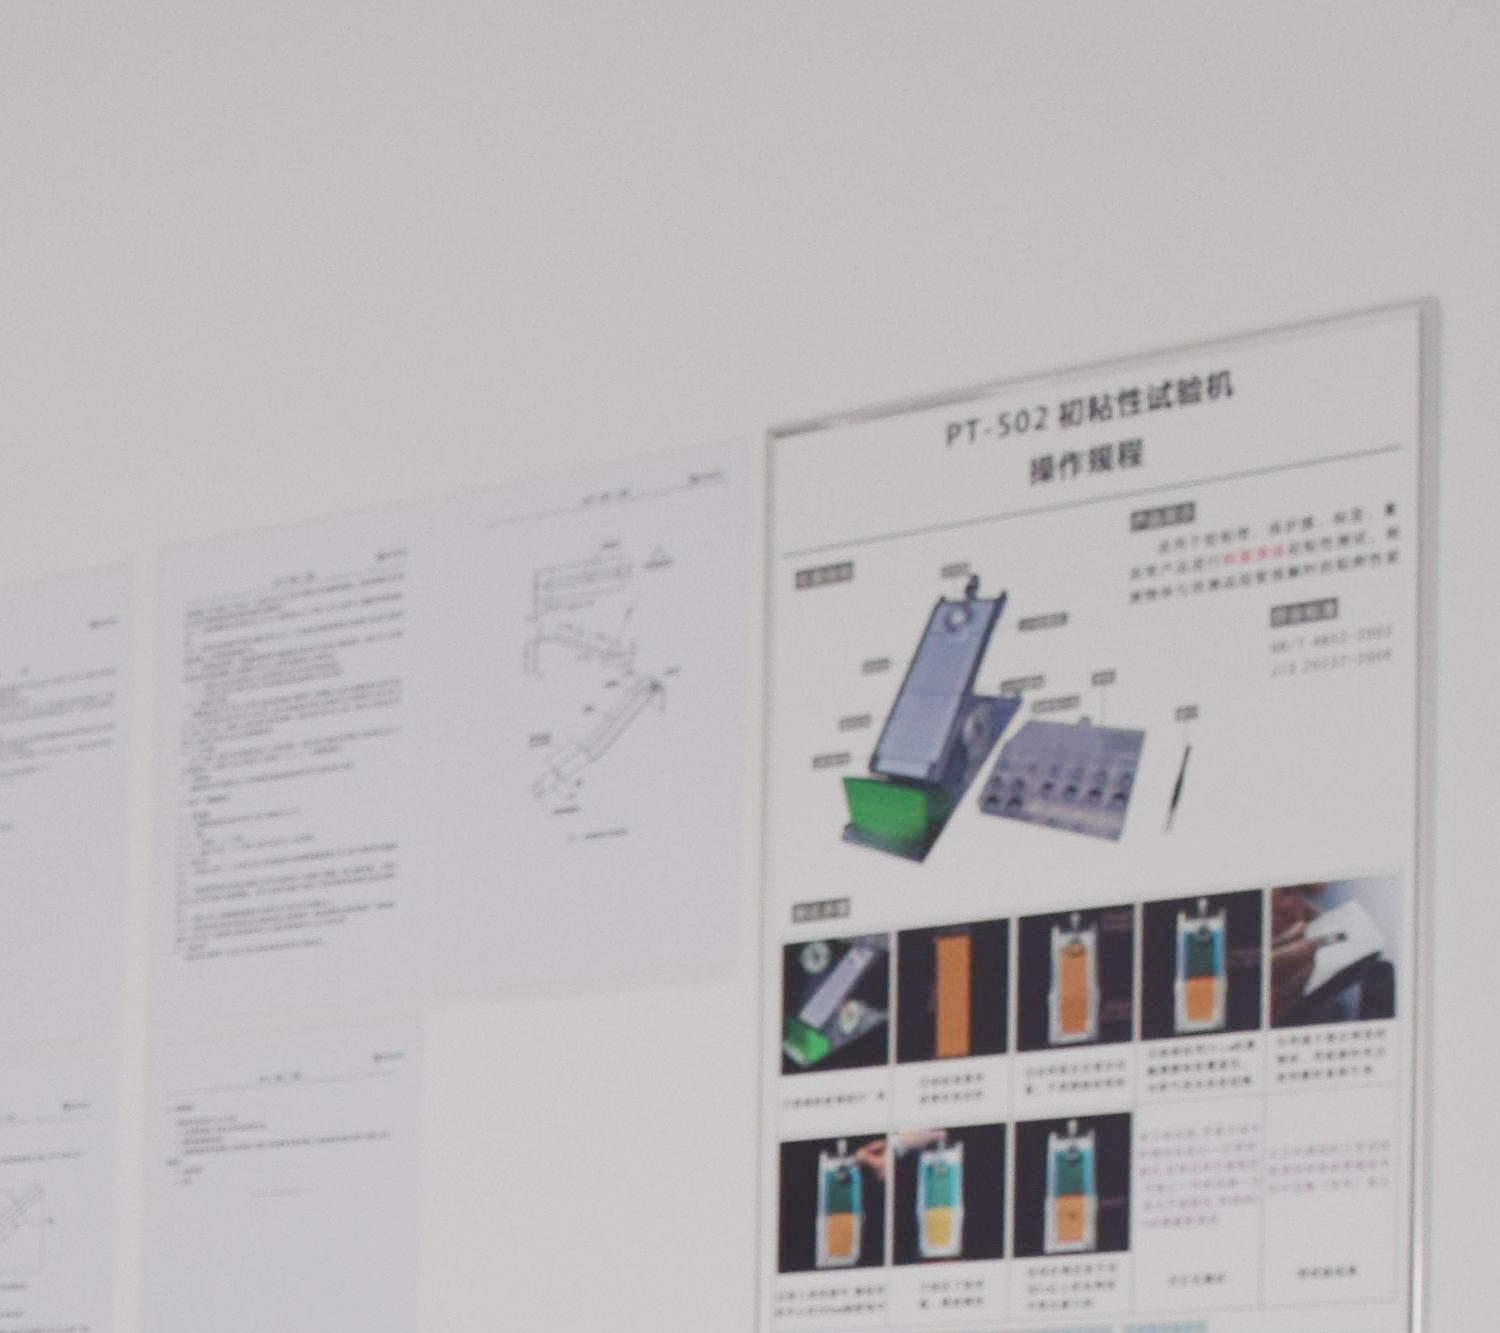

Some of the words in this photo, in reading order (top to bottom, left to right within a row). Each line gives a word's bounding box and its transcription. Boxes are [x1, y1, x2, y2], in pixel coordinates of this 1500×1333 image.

[946, 406, 1049, 446] PT-502
[1058, 370, 1236, 429] 初粘性试验机
[1029, 438, 1145, 487] 操作规程
